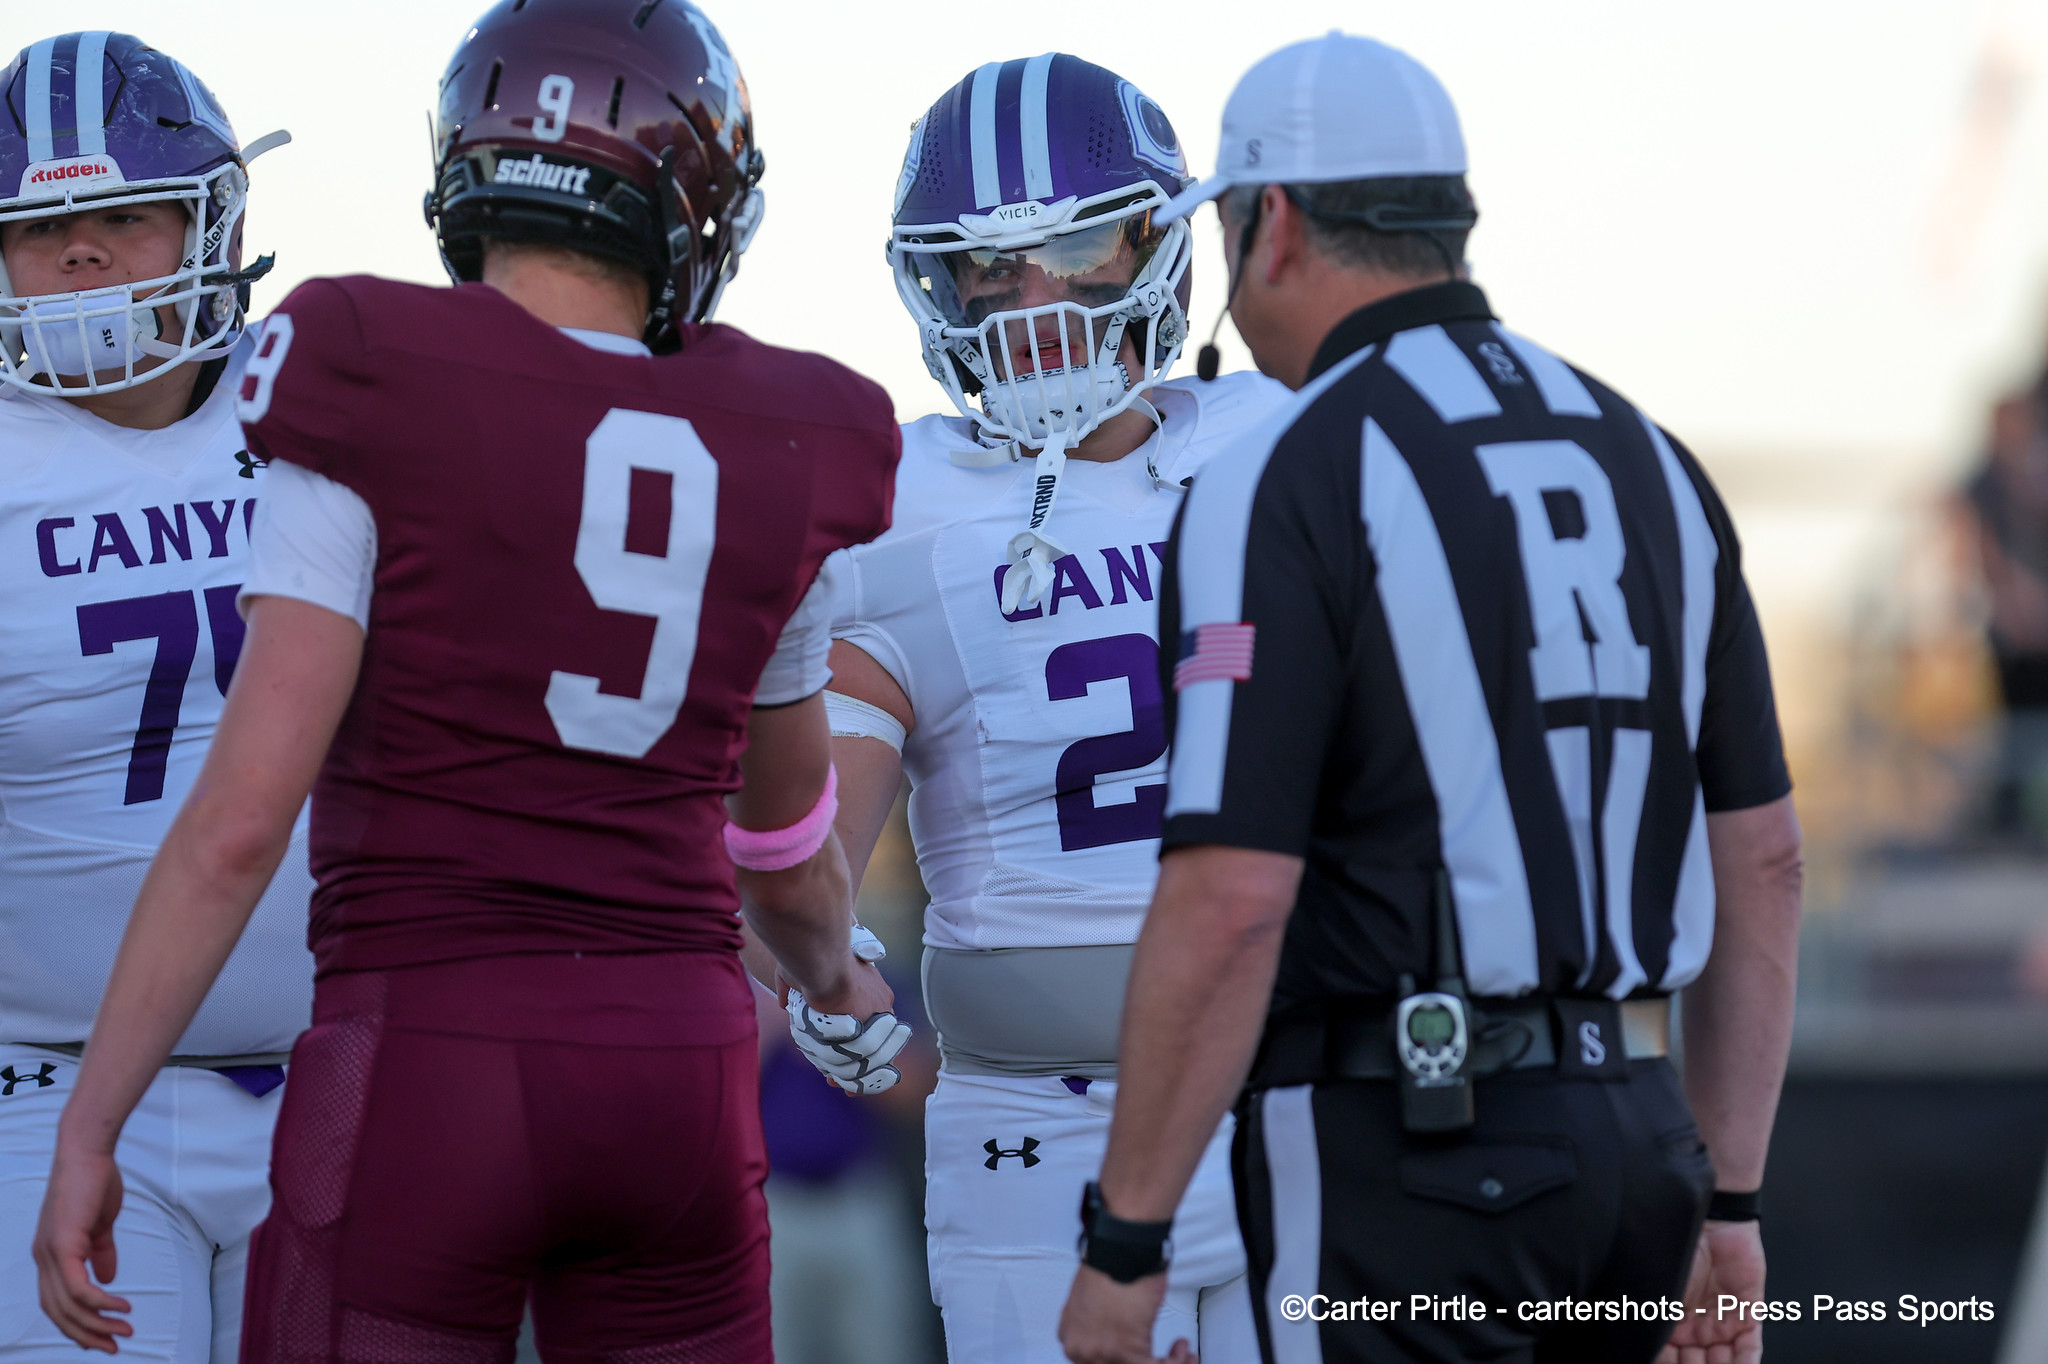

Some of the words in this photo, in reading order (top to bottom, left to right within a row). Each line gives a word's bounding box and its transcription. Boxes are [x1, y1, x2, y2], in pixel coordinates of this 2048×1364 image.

[532, 74, 574, 143] 9
[494, 154, 591, 195] schutt
[999, 206, 1037, 220] VICIS
[102, 328, 115, 348] SLF
[237, 313, 294, 423] 9
[1029, 474, 1056, 529] NXTRND
[36, 498, 258, 577] CANY
[1475, 439, 1651, 702] R
[544, 407, 719, 759] 9
